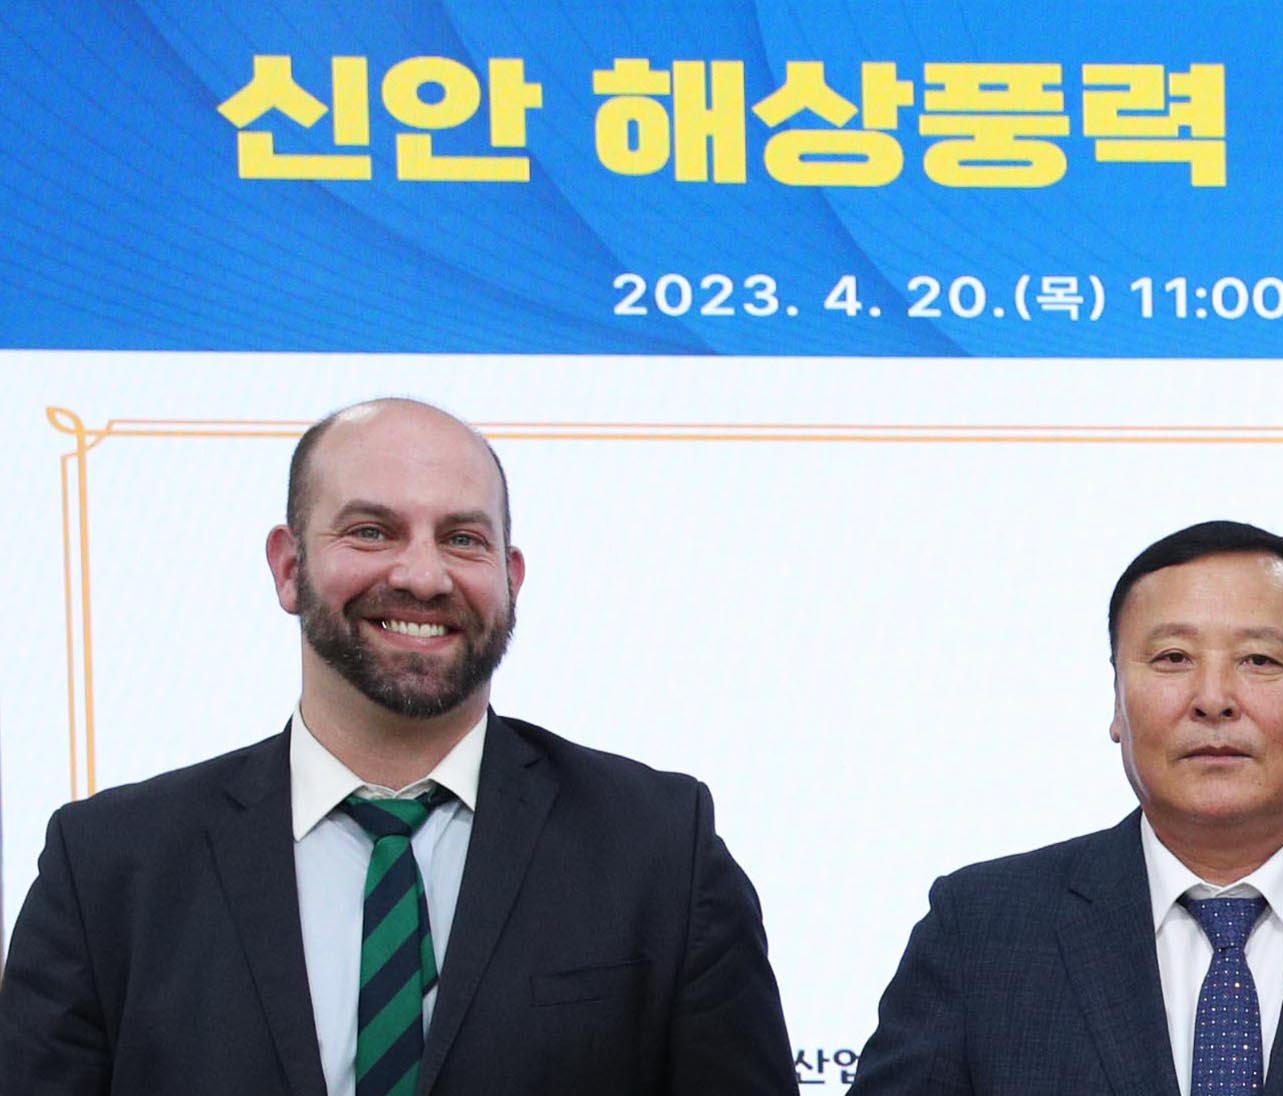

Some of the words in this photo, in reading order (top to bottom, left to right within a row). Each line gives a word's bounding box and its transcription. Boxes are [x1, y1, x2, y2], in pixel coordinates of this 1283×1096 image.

[217, 54, 543, 182] 신안
[592, 58, 1227, 188] 해상풍력
[613, 273, 798, 316] 2023.
[824, 275, 881, 317] 4.
[907, 274, 1105, 321] 20.(목)
